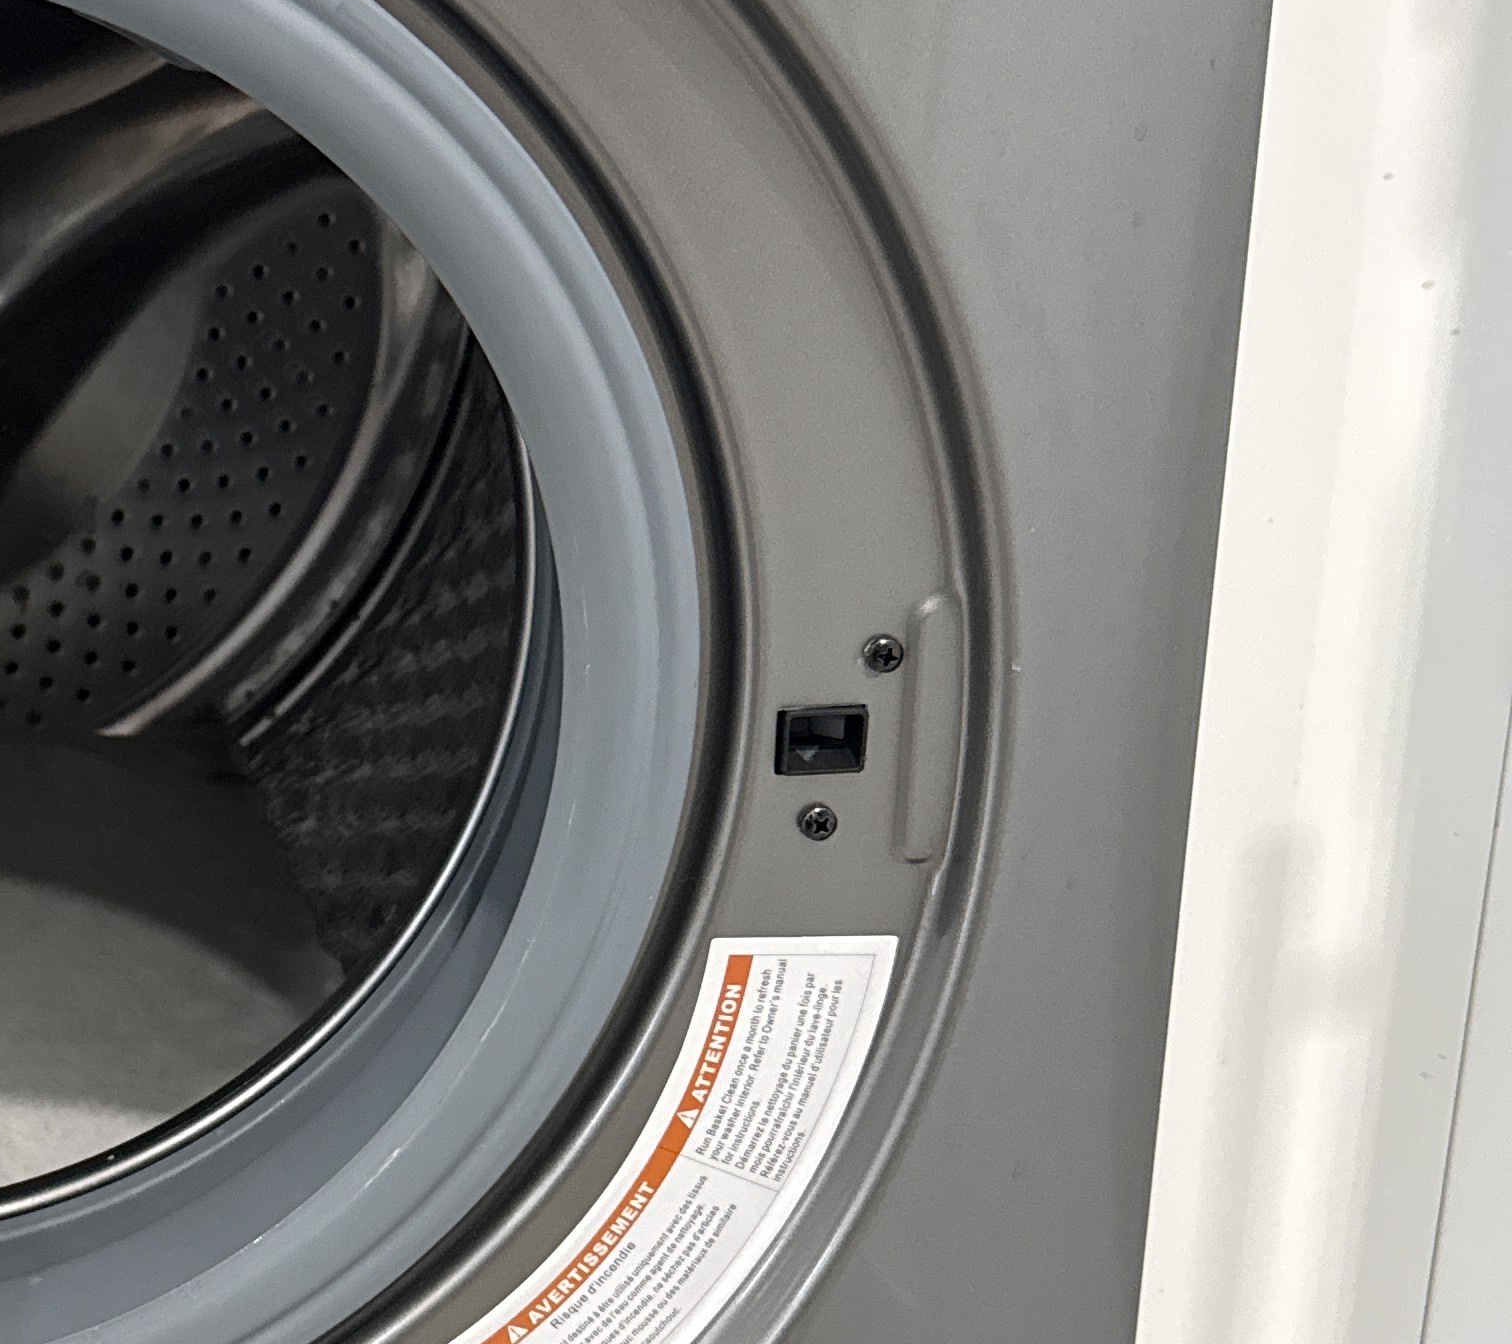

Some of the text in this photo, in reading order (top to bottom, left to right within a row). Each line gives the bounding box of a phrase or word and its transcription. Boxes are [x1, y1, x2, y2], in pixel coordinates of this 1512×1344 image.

[757, 968, 772, 1002] refresh
[773, 959, 787, 994] manual
[832, 980, 843, 994] les
[752, 1004, 764, 1014] to
[763, 995, 779, 1034] Owner's
[828, 997, 840, 1017] pour
[691, 984, 743, 1103] ATTENTION
[748, 1015, 758, 1045] month
[758, 1034, 770, 1045] to
[735, 1053, 748, 1075] once
[736, 973, 815, 1170] Démarrez le nettoyage du panier une fois par
[752, 1046, 765, 1071] Refer
[722, 1078, 739, 1104] Clean
[749, 1151, 766, 1173] mois
[803, 1034, 816, 1047] du
[798, 1073, 814, 1107] manuel
[707, 1105, 727, 1137] Basket
[722, 1108, 741, 1139] washer
[792, 1107, 803, 1119] au
[695, 1136, 712, 1156] Run
[708, 1140, 725, 1161] your
[721, 1151, 734, 1165] for
[527, 1181, 655, 1325] AVERTISSEMENT
[550, 1241, 636, 1330] Risque d'incendie
